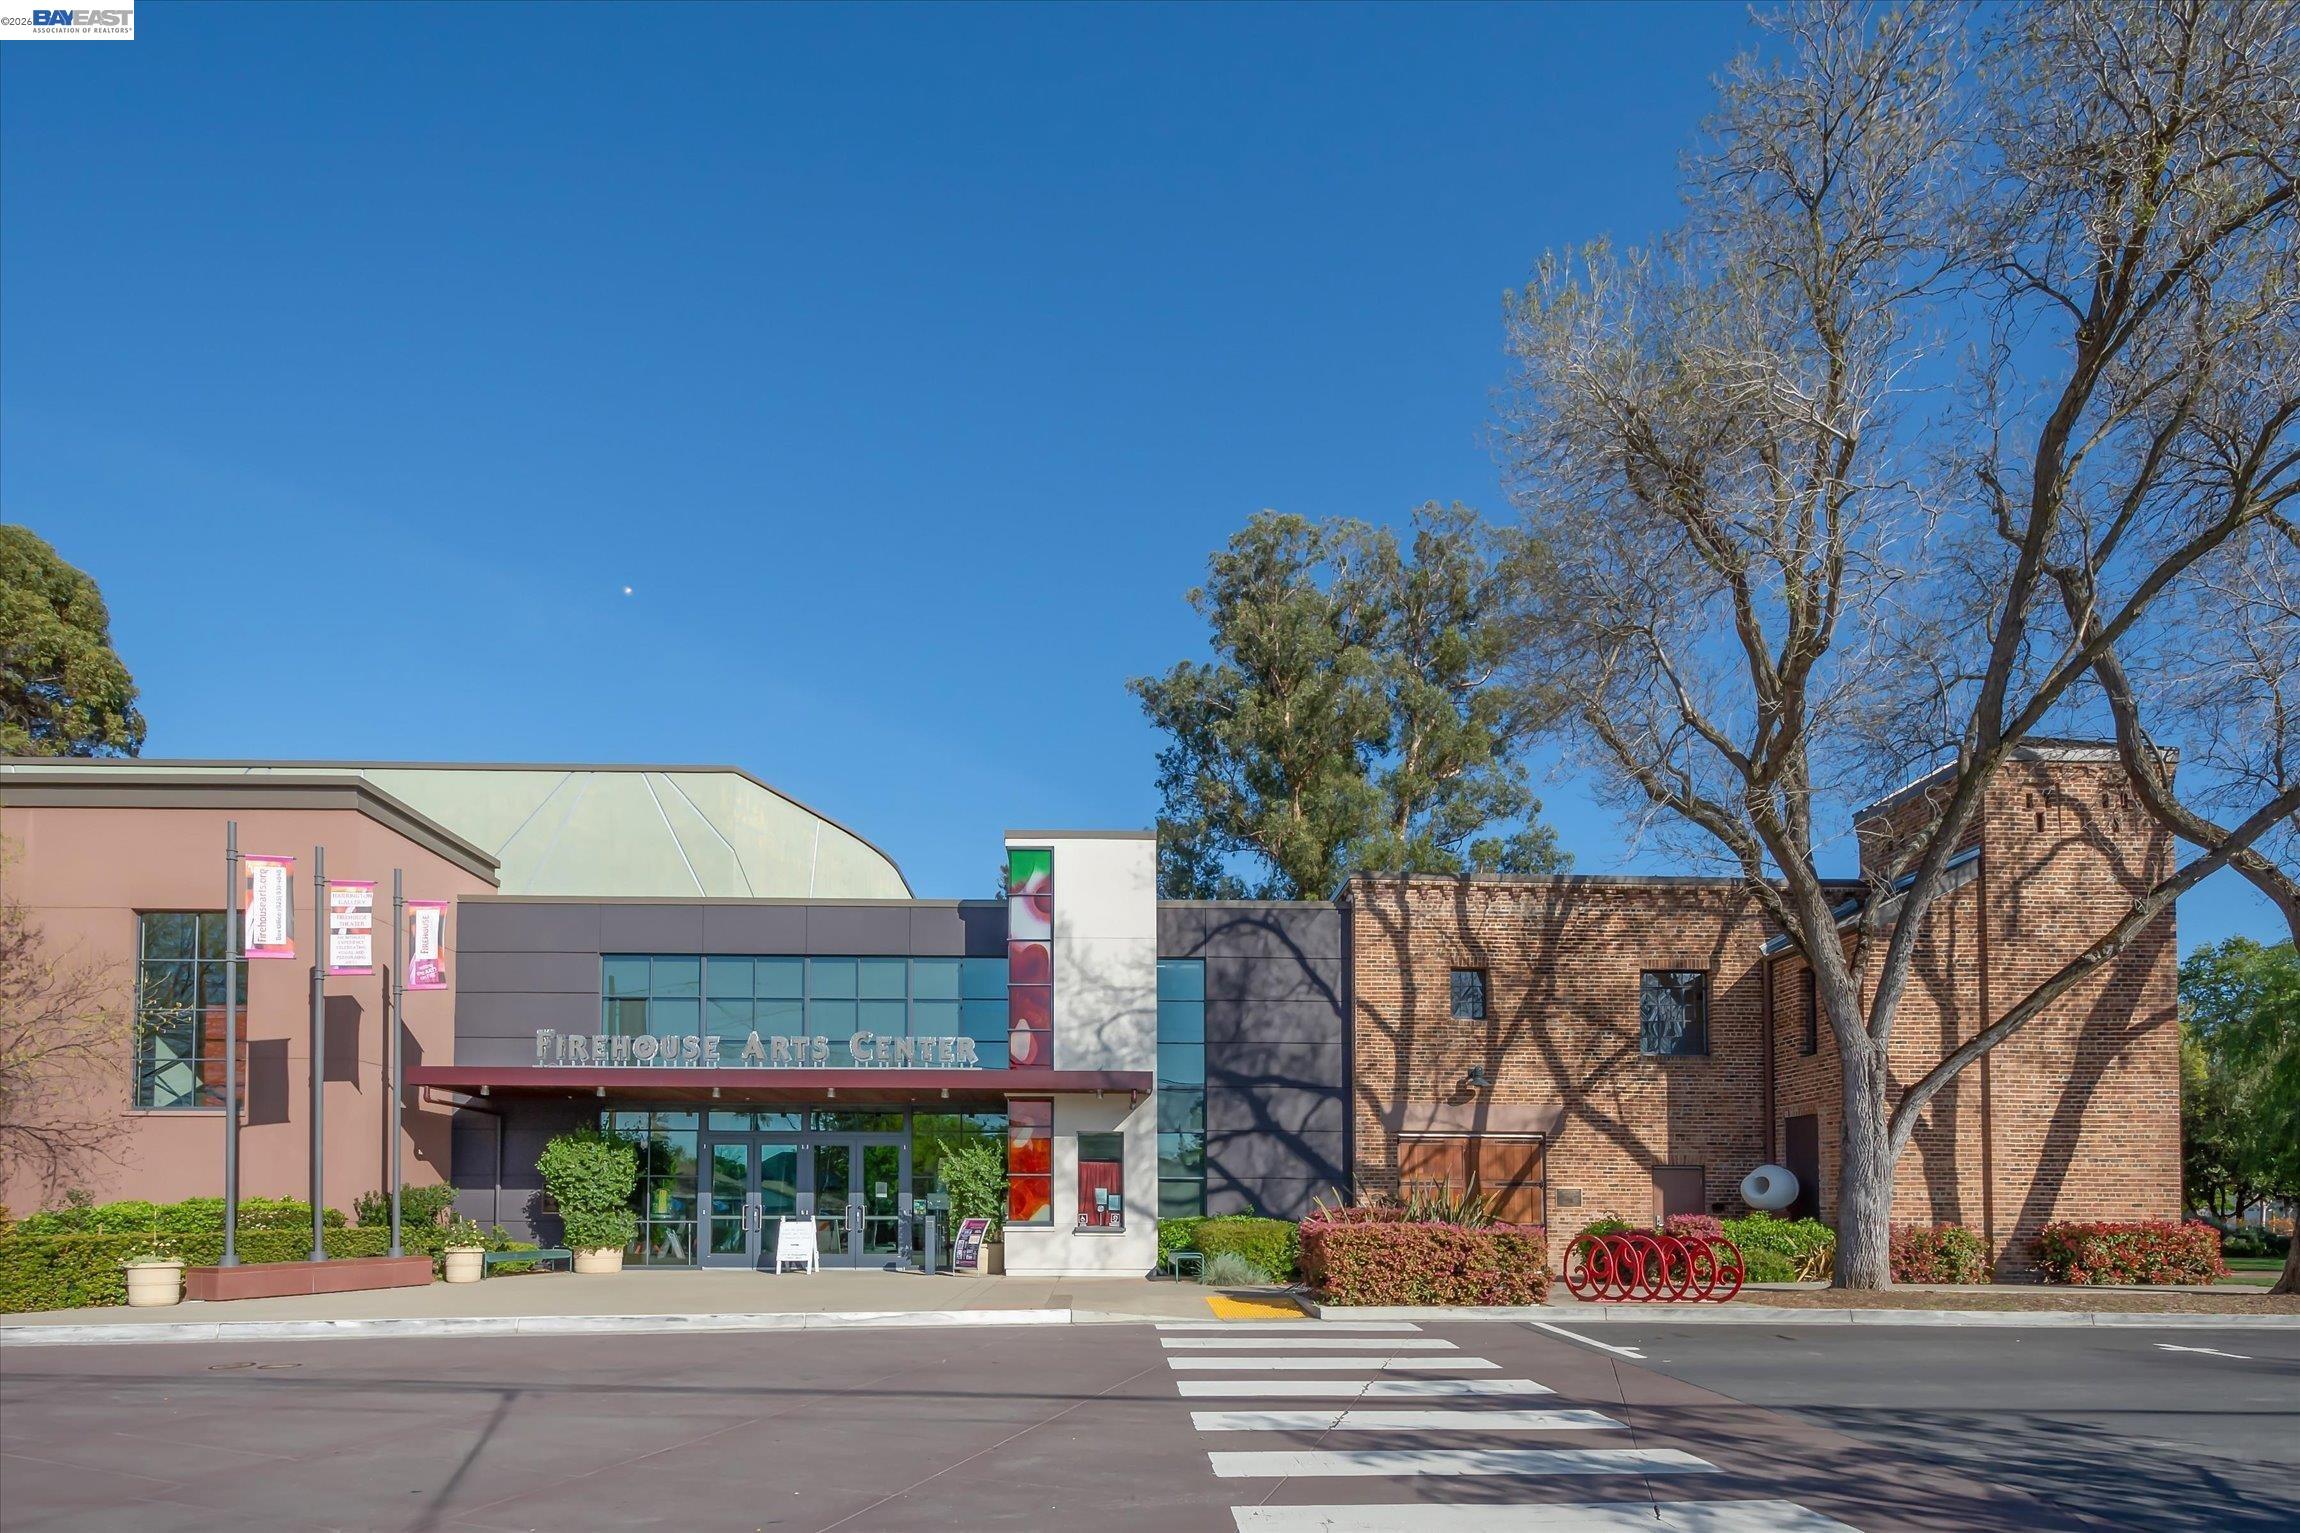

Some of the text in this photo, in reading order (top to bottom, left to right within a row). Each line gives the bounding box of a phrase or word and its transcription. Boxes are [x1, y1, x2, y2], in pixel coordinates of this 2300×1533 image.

[536, 1028, 980, 1063] FIREHOUSE ARTS CENTER
